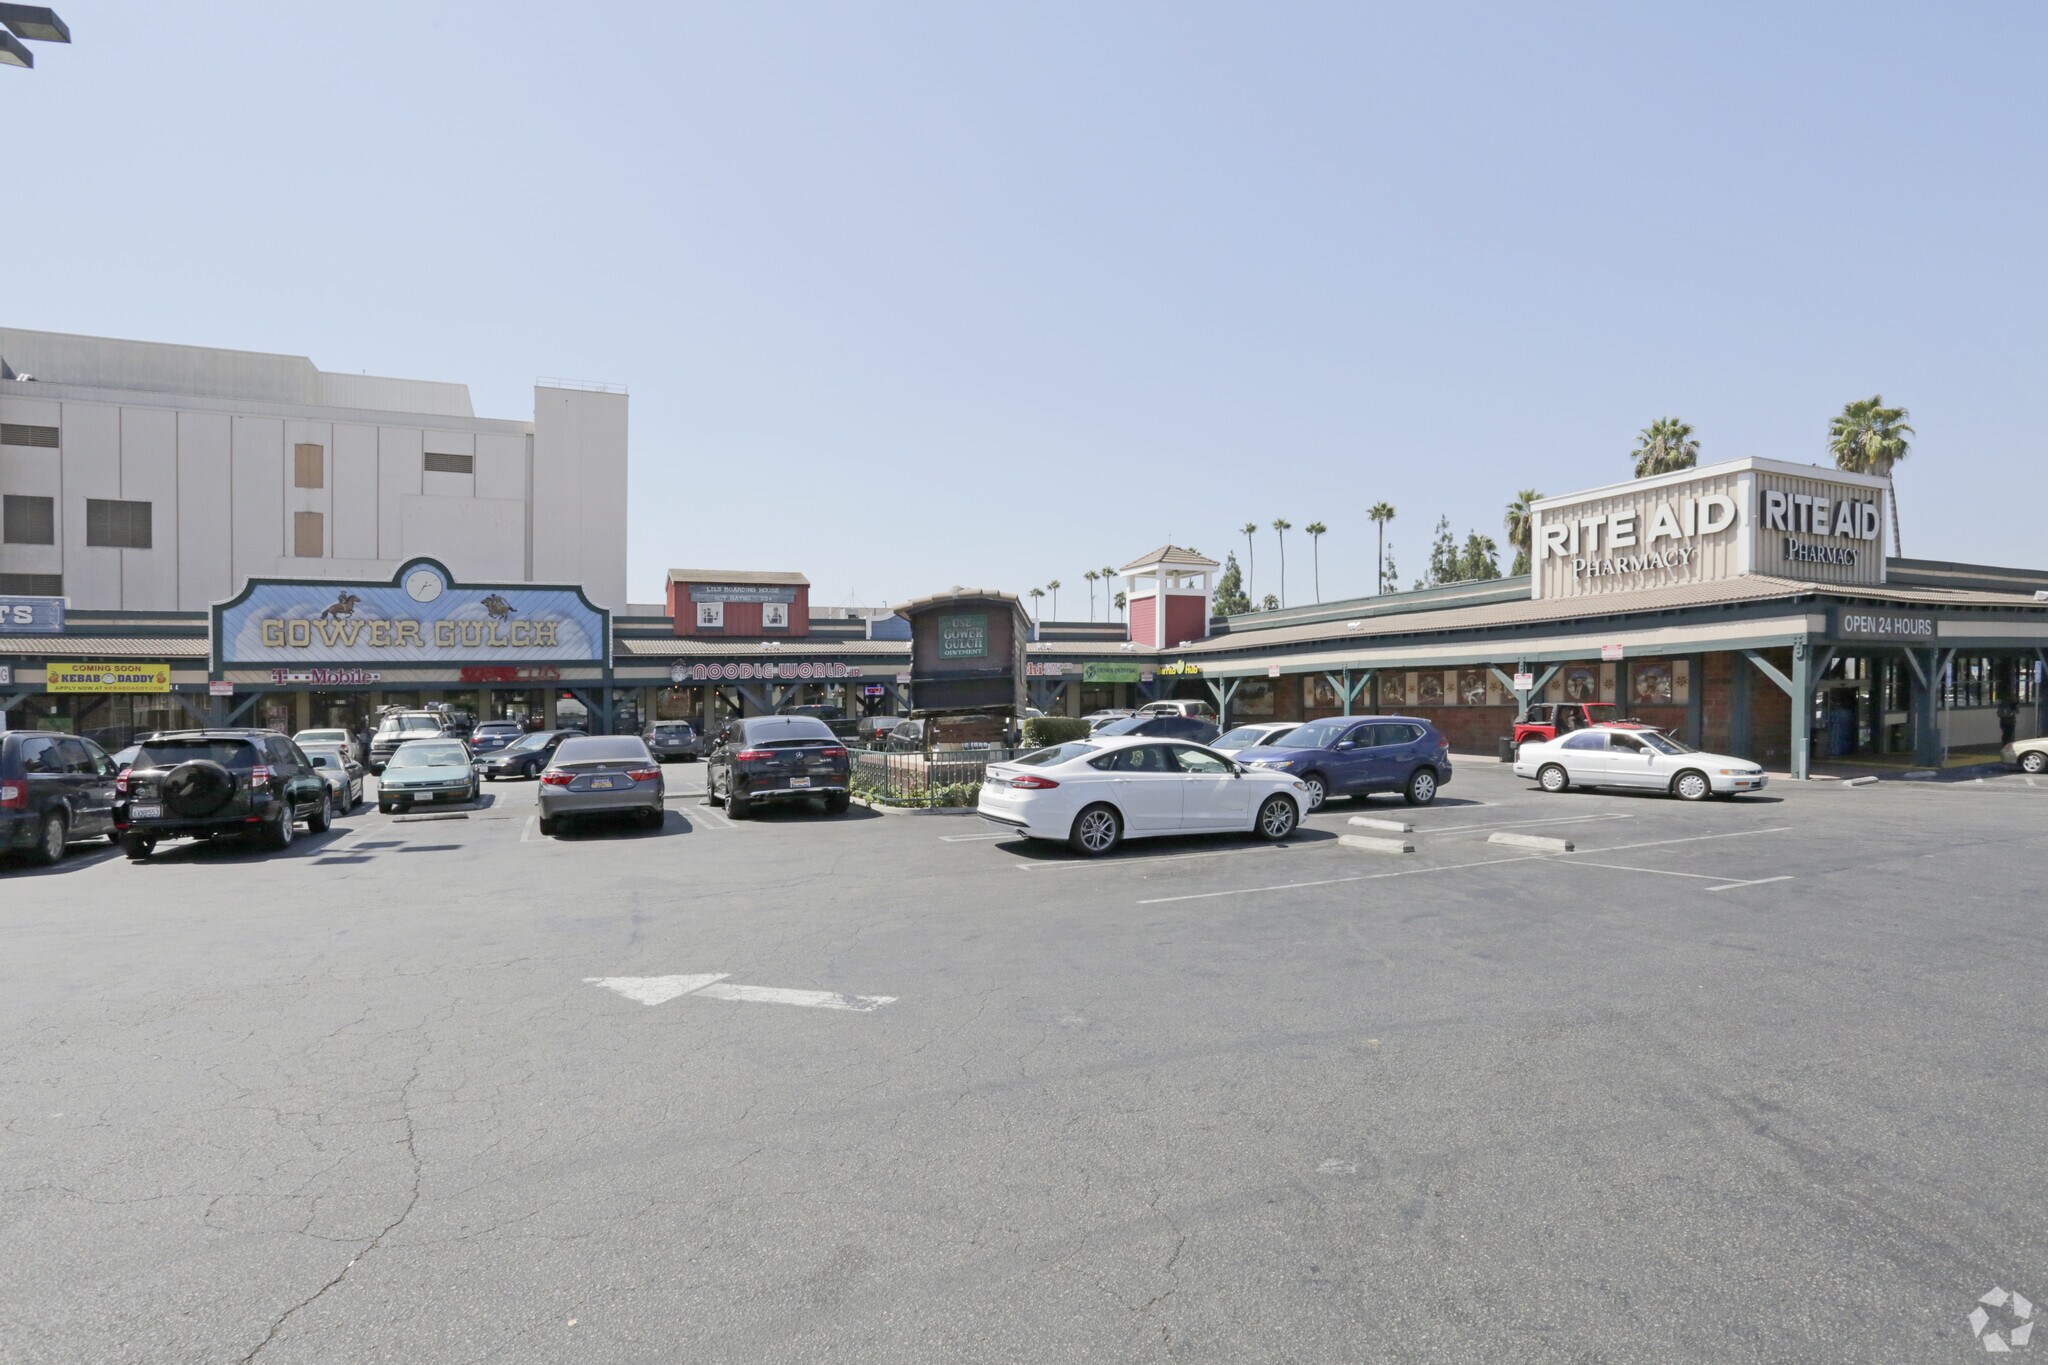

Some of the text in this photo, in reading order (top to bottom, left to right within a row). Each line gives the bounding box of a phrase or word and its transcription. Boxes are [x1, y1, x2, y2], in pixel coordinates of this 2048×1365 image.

[1762, 490, 1881, 541] RITE AID
[1541, 494, 1738, 560] RITE AID
[952, 618, 972, 627] USE
[1844, 614, 1933, 635] OPEN 24 HOURS
[261, 619, 559, 648] GOWER GULCH
[943, 627, 983, 640] GOWER
[944, 638, 983, 650] GULCH
[944, 648, 983, 656] OINTMENT
[61, 674, 155, 683] KEBAB DADDY
[692, 662, 774, 680] NOODLE
[778, 662, 847, 678] WORLD
